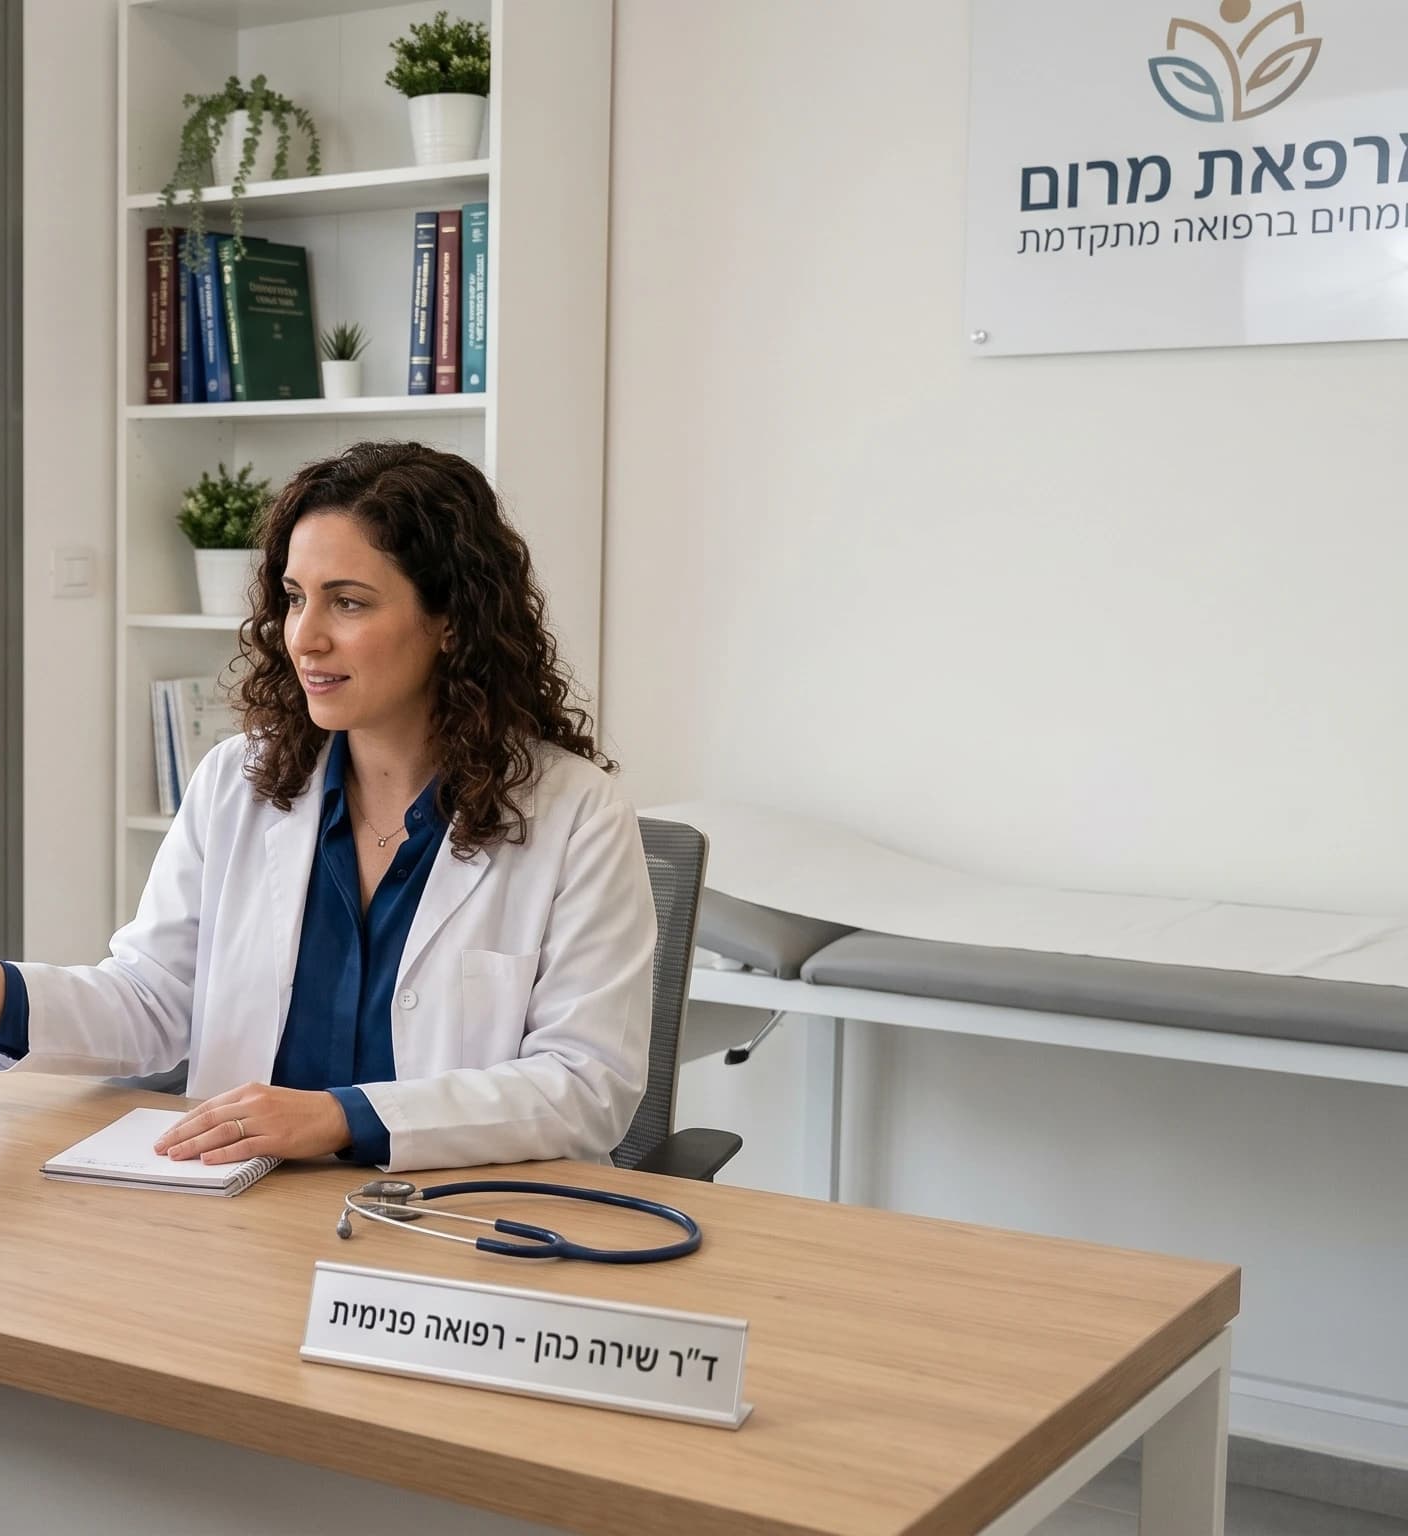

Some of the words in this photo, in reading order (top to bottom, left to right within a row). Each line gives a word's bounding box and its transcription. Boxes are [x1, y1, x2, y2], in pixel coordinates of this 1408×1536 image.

[1020, 155, 1172, 212] מרום
[1193, 132, 1408, 200] רפאת
[1017, 220, 1160, 257] מתקדמת
[1173, 211, 1298, 244] ברפואה
[329, 1301, 416, 1335] פנימית
[424, 1314, 505, 1350] רפואה
[534, 1331, 579, 1364] כהן
[588, 1339, 659, 1373] שירה
